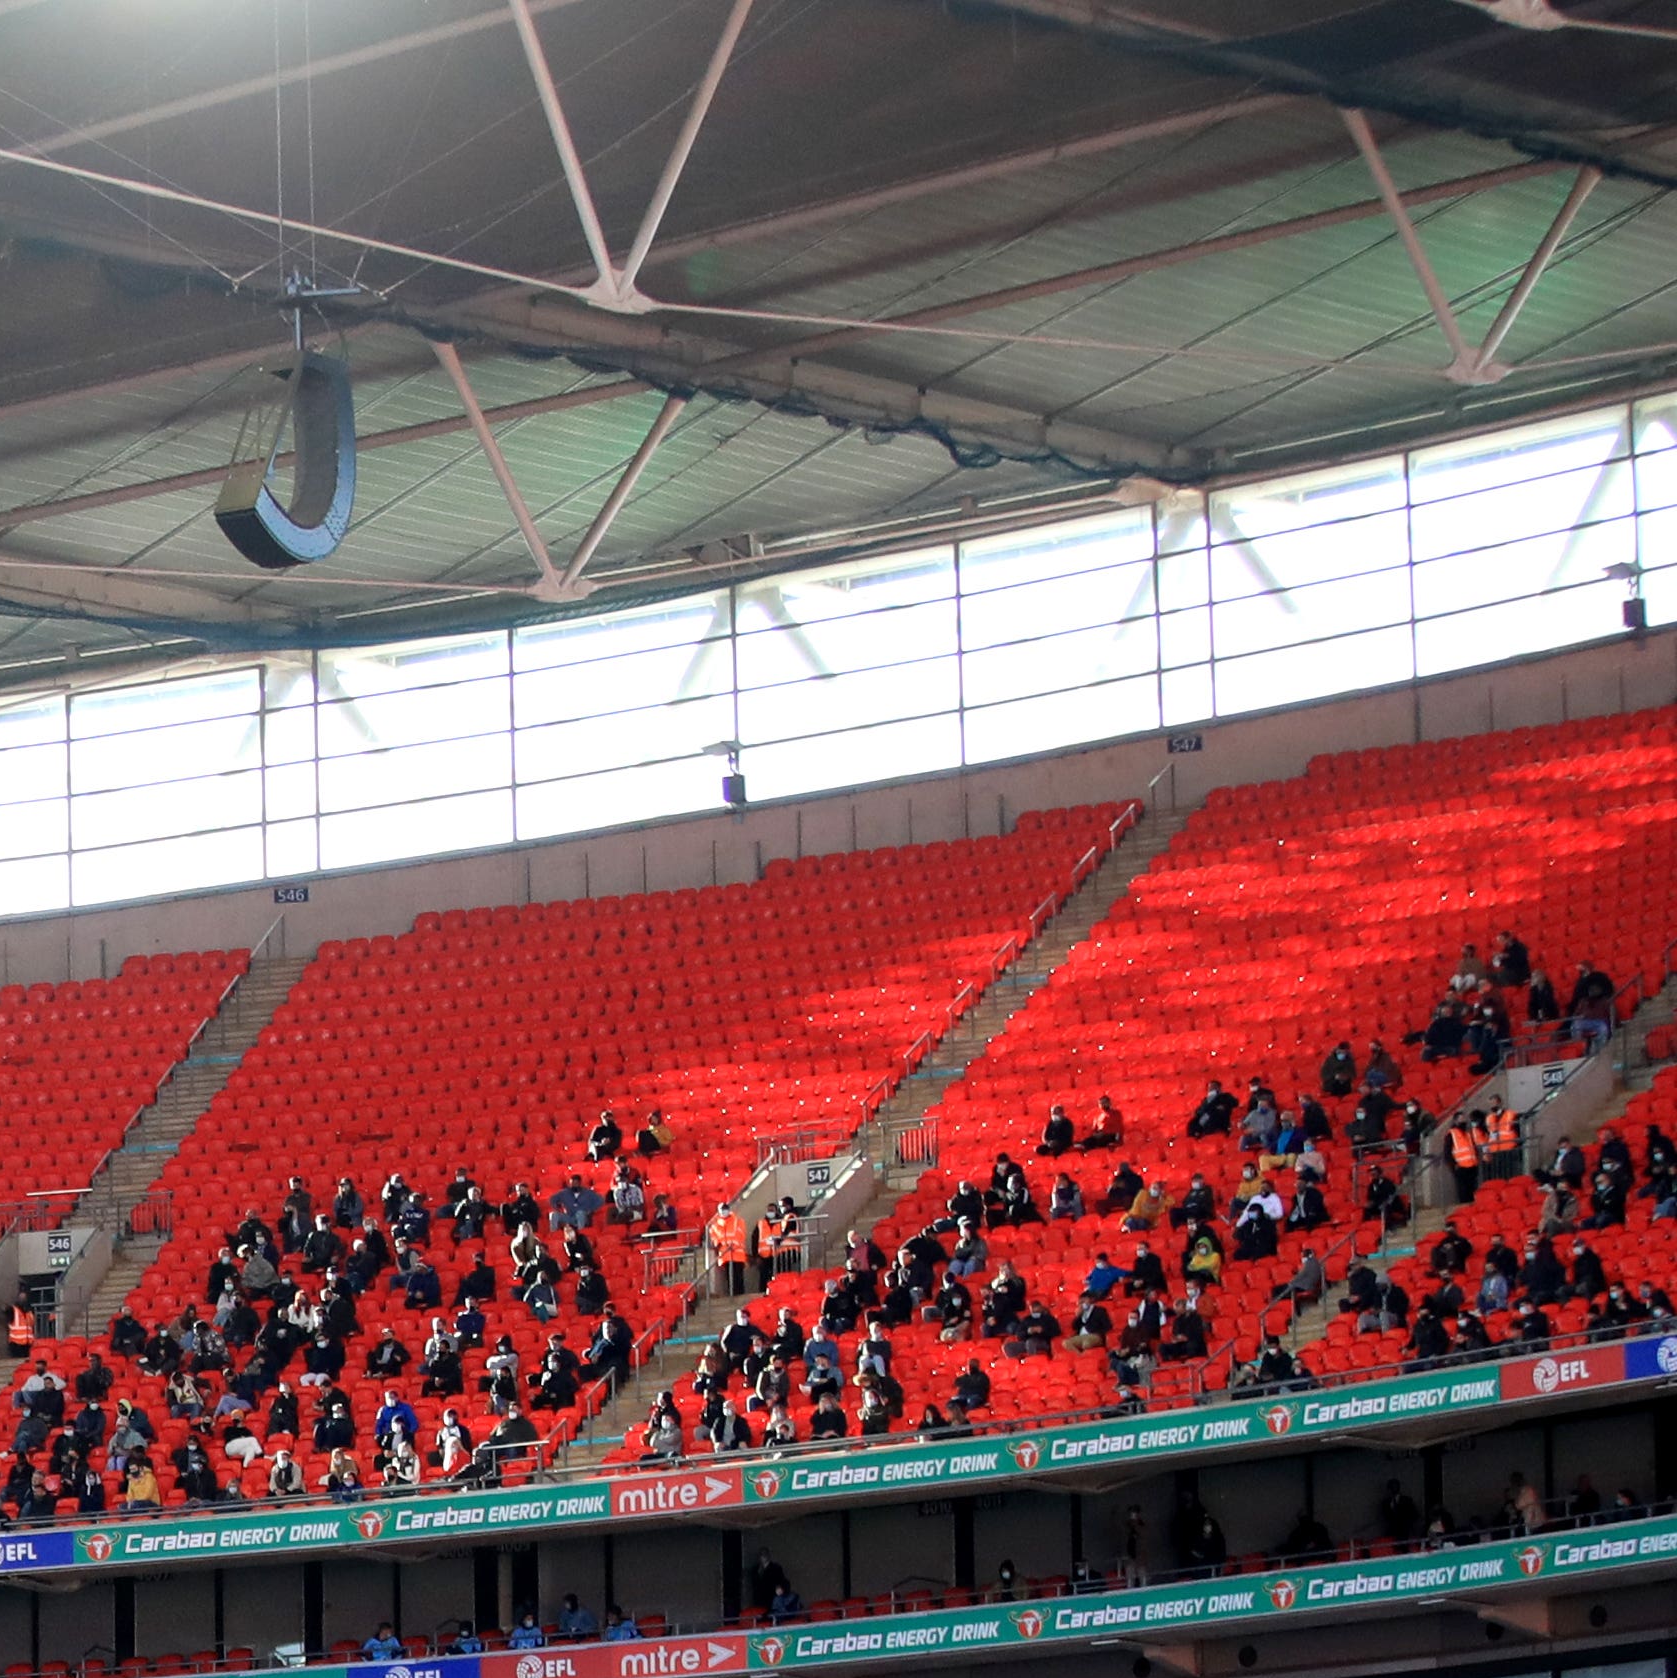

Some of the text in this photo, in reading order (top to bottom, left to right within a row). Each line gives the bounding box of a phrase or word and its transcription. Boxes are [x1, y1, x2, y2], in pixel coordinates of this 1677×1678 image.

[808, 1170, 828, 1183] 547
[49, 1239, 69, 1250] 546
[1560, 1361, 1589, 1381] EFL
[1304, 1380, 1495, 1424] Carabao ENERGY DRINK
[1052, 1418, 1249, 1461] Carabao ENERGY DRINK
[792, 1454, 998, 1489] Carabao ENERGY DRINK
[396, 1496, 605, 1530] Carabao ENERGY DRINK
[619, 1480, 697, 1514] mitre
[6, 1543, 36, 1561] EFL
[126, 1523, 339, 1553] Carabao ENERGY DRINK
[1555, 1539, 1640, 1567] Carabao
[1308, 1559, 1503, 1602] Carabao ENERGY DRINK
[1056, 1593, 1253, 1629] Carabao ENERGY DRINK
[797, 1622, 999, 1656] Carabao ENERGY DRINK
[546, 1659, 575, 1677] EFL
[621, 1646, 699, 1677] mitre
